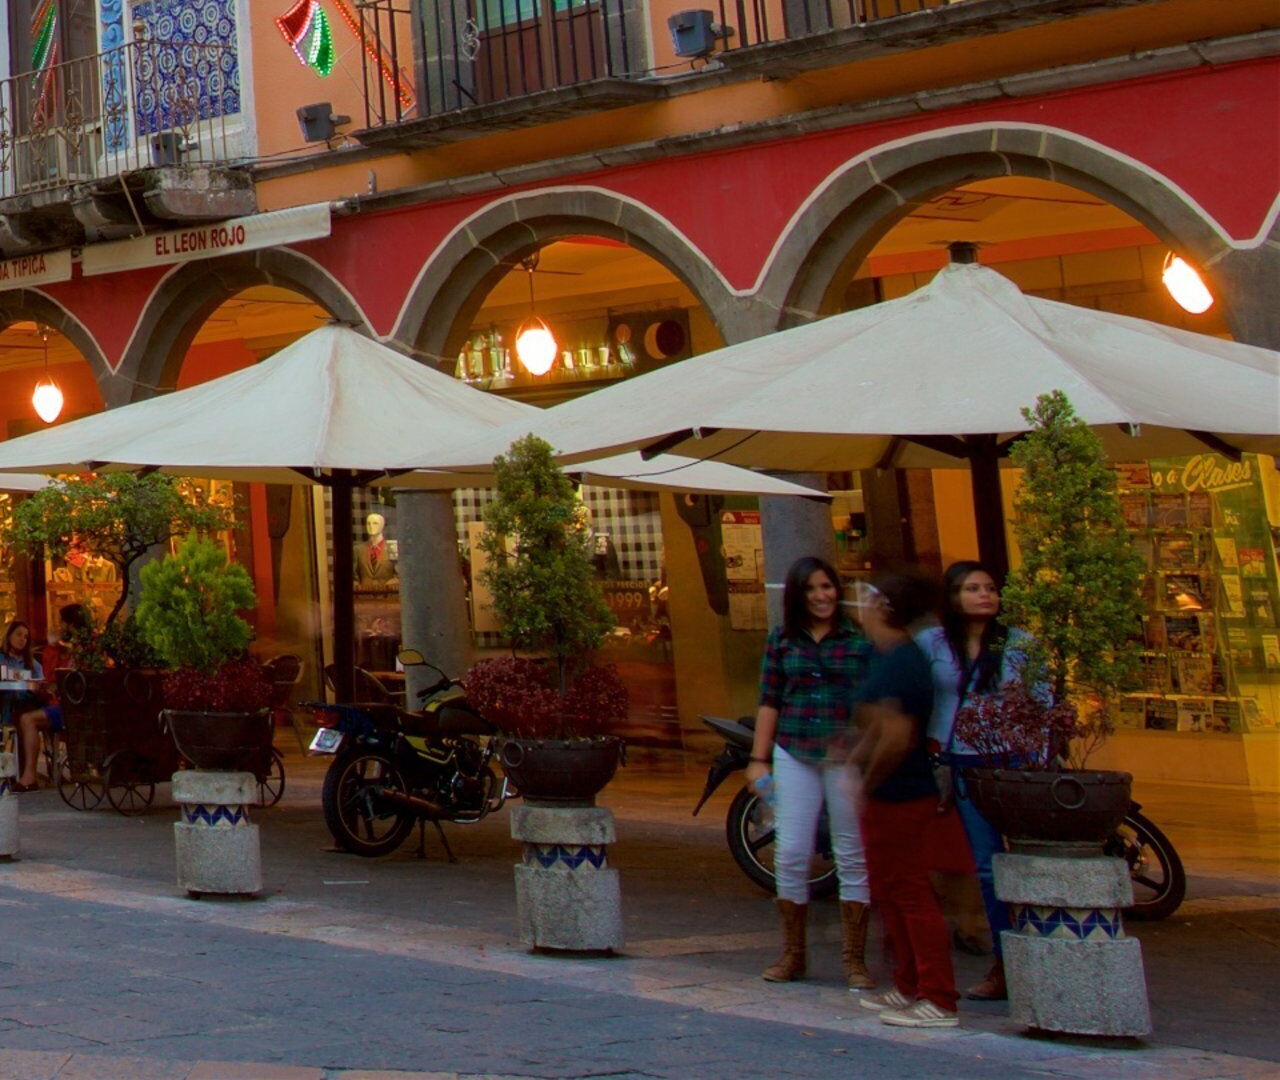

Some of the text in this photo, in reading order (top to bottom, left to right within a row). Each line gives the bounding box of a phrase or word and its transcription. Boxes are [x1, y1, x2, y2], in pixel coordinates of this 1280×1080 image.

[155, 225, 245, 256] EL LEON ROJO
[1181, 455, 1251, 492] Clases
